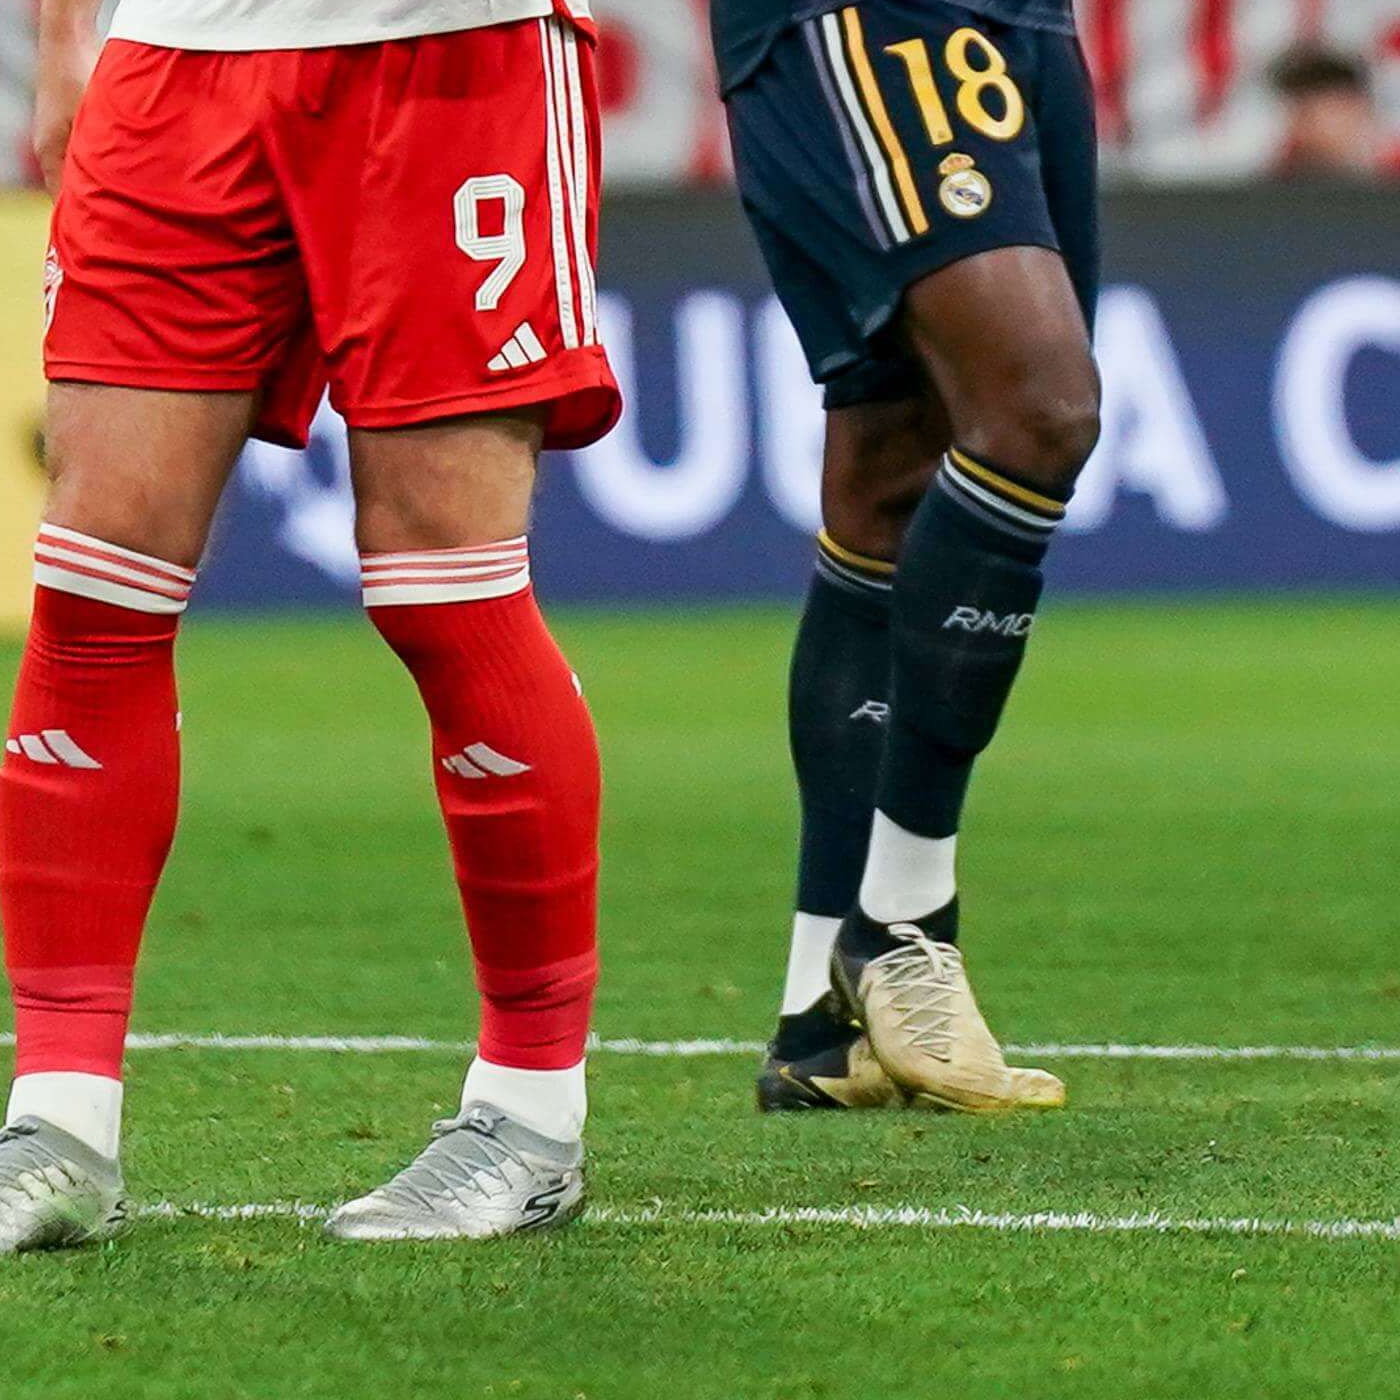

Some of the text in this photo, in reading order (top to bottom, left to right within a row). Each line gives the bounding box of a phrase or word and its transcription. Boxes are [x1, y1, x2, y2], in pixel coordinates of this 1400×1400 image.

[883, 27, 1025, 146] 18
[453, 173, 526, 312] 9
[570, 284, 1229, 542] UA
